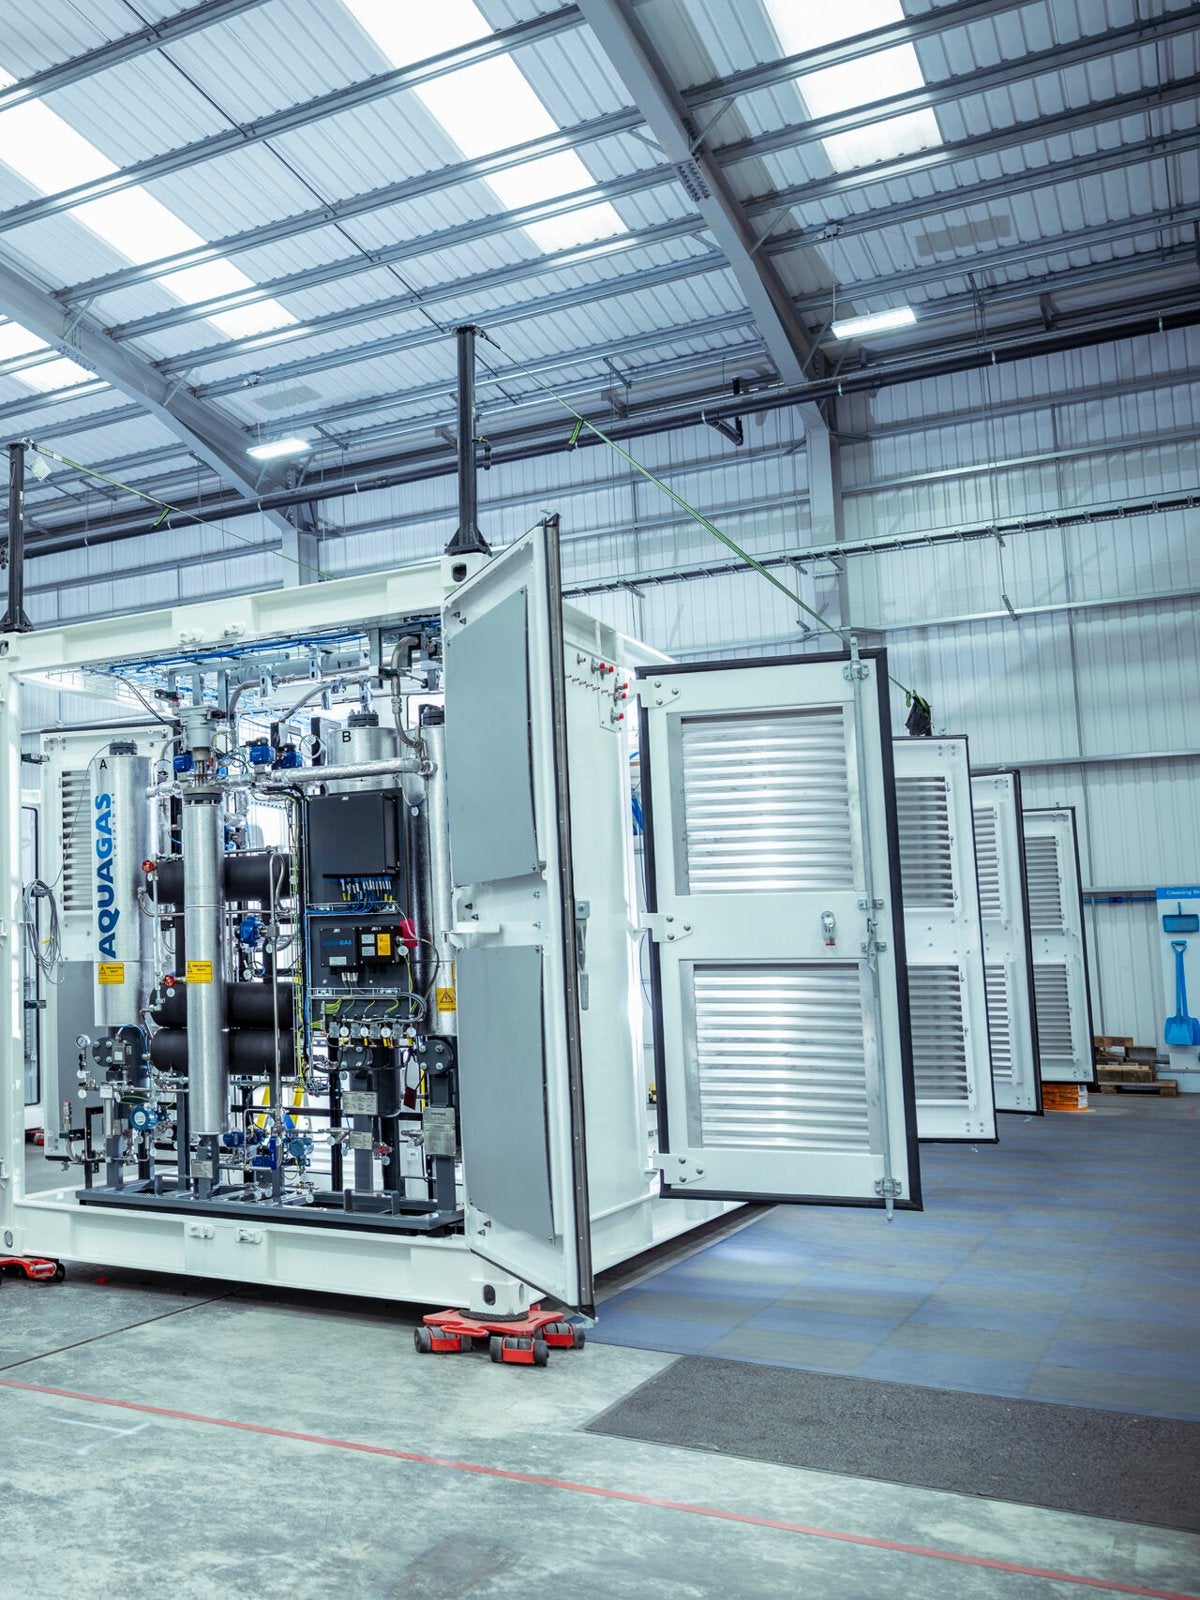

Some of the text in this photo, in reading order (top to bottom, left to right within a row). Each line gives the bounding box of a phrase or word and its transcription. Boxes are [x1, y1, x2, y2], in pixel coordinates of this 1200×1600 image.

[342, 731, 351, 743] B
[100, 759, 108, 769] A
[95, 792, 120, 959] AQUAGAS
